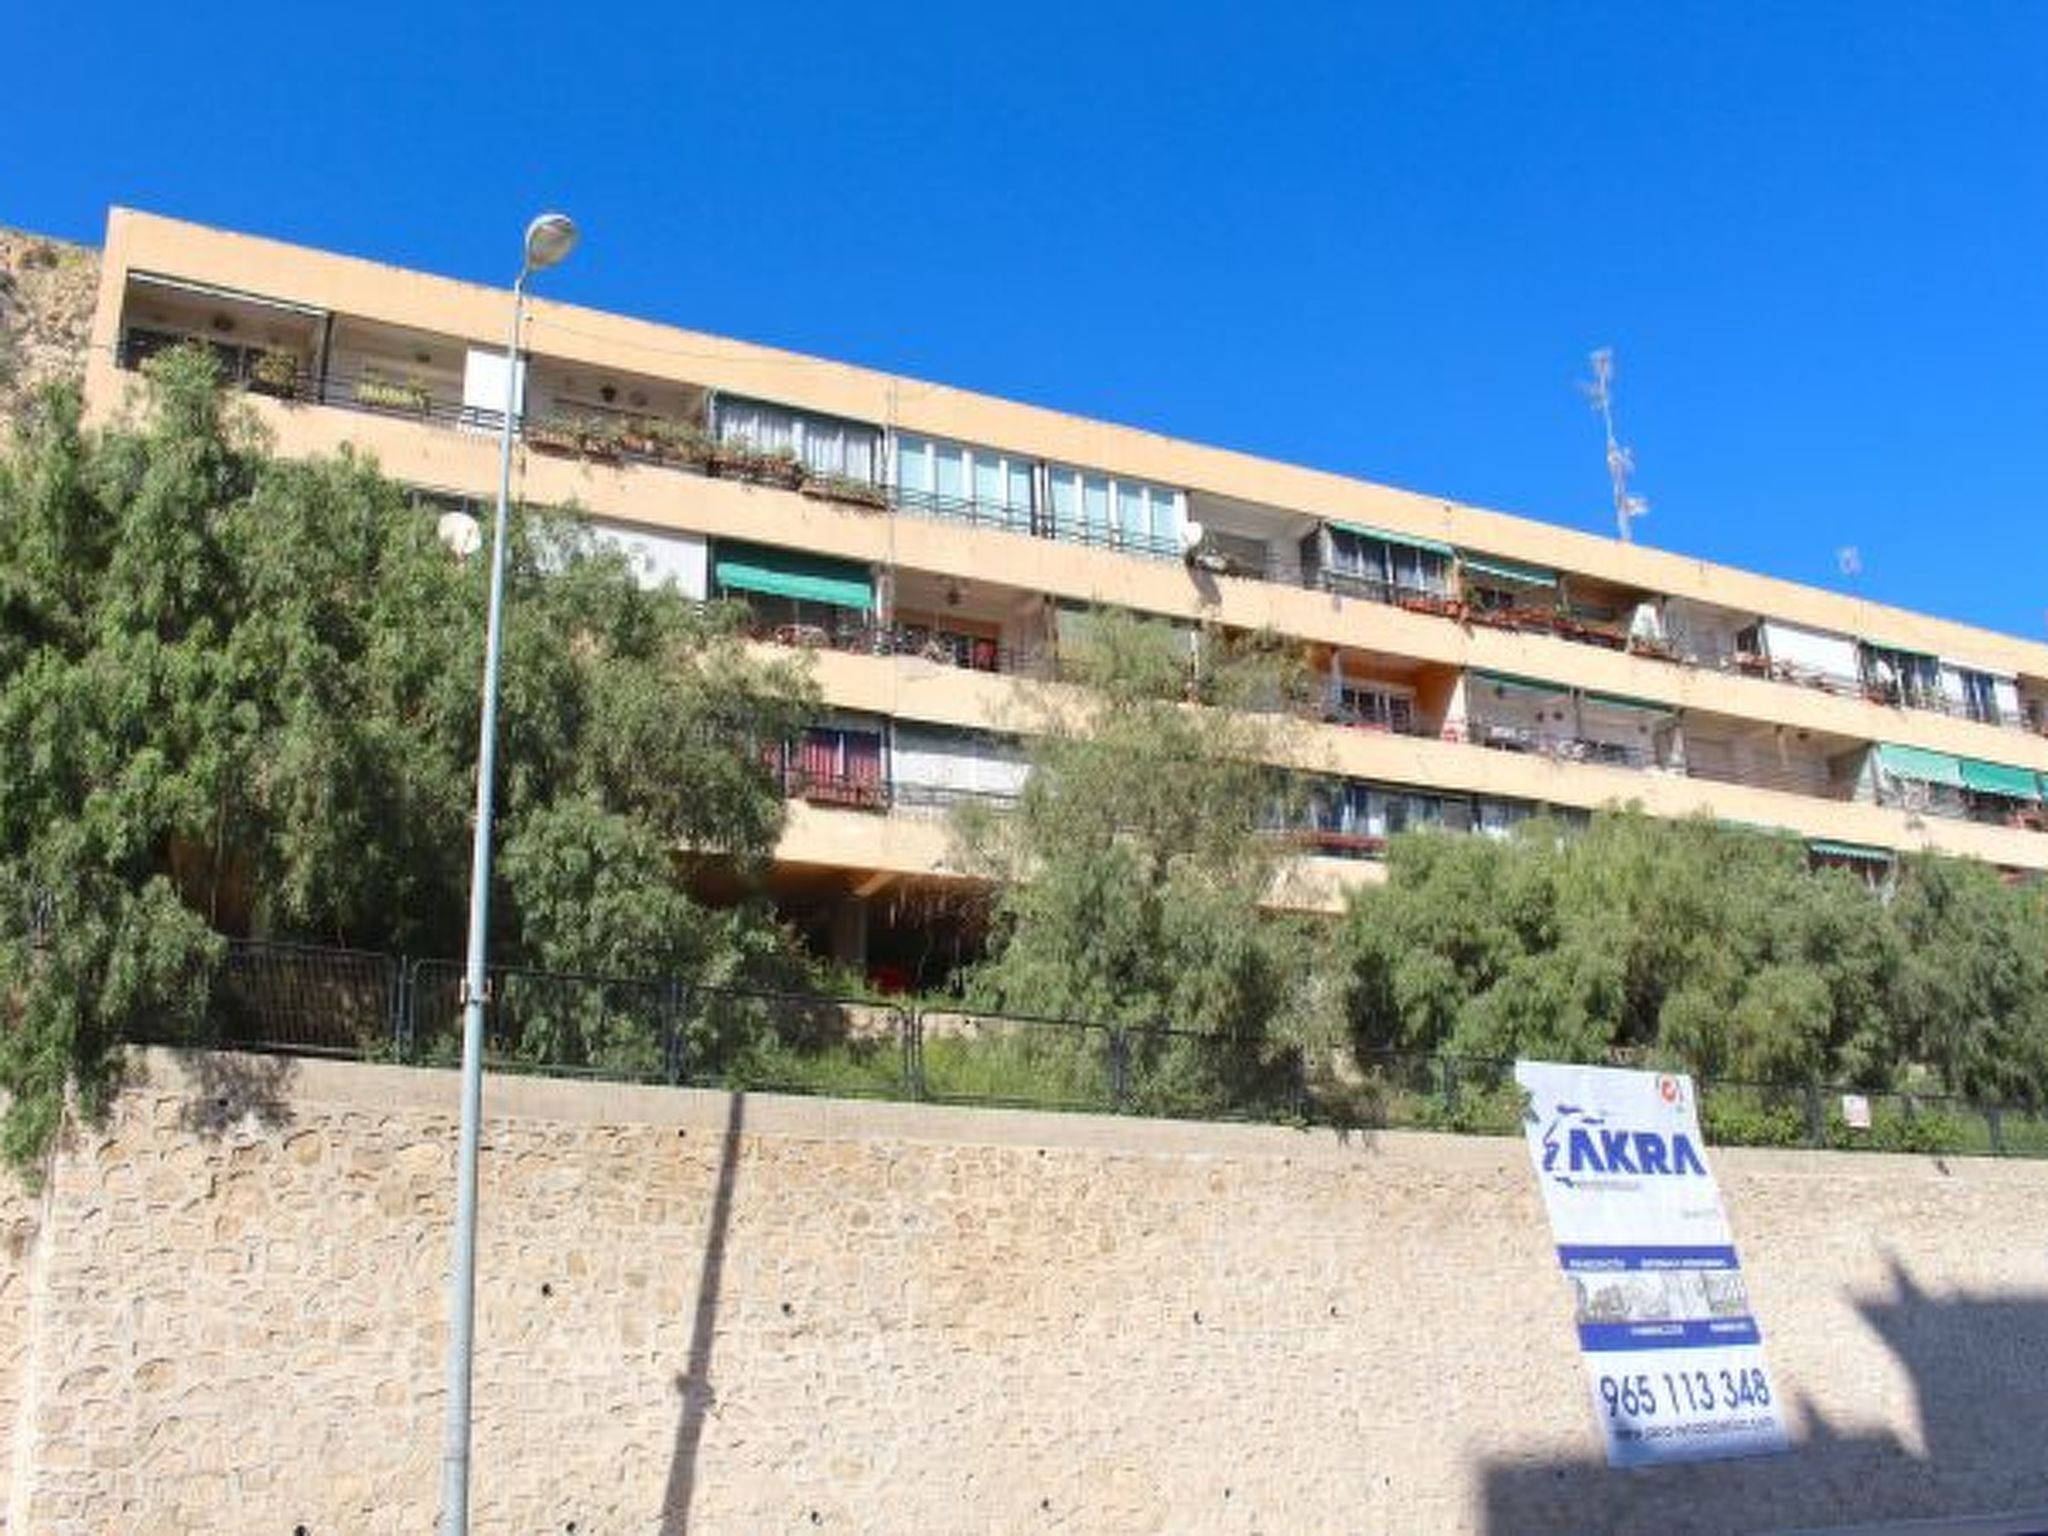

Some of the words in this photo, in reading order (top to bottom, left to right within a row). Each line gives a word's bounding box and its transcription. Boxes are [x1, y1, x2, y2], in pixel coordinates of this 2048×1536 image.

[1569, 1128, 1707, 1176] AKRA
[1600, 1375, 1656, 1418] 965
[1663, 1371, 1714, 1413] 113
[1719, 1367, 1770, 1408] 348
